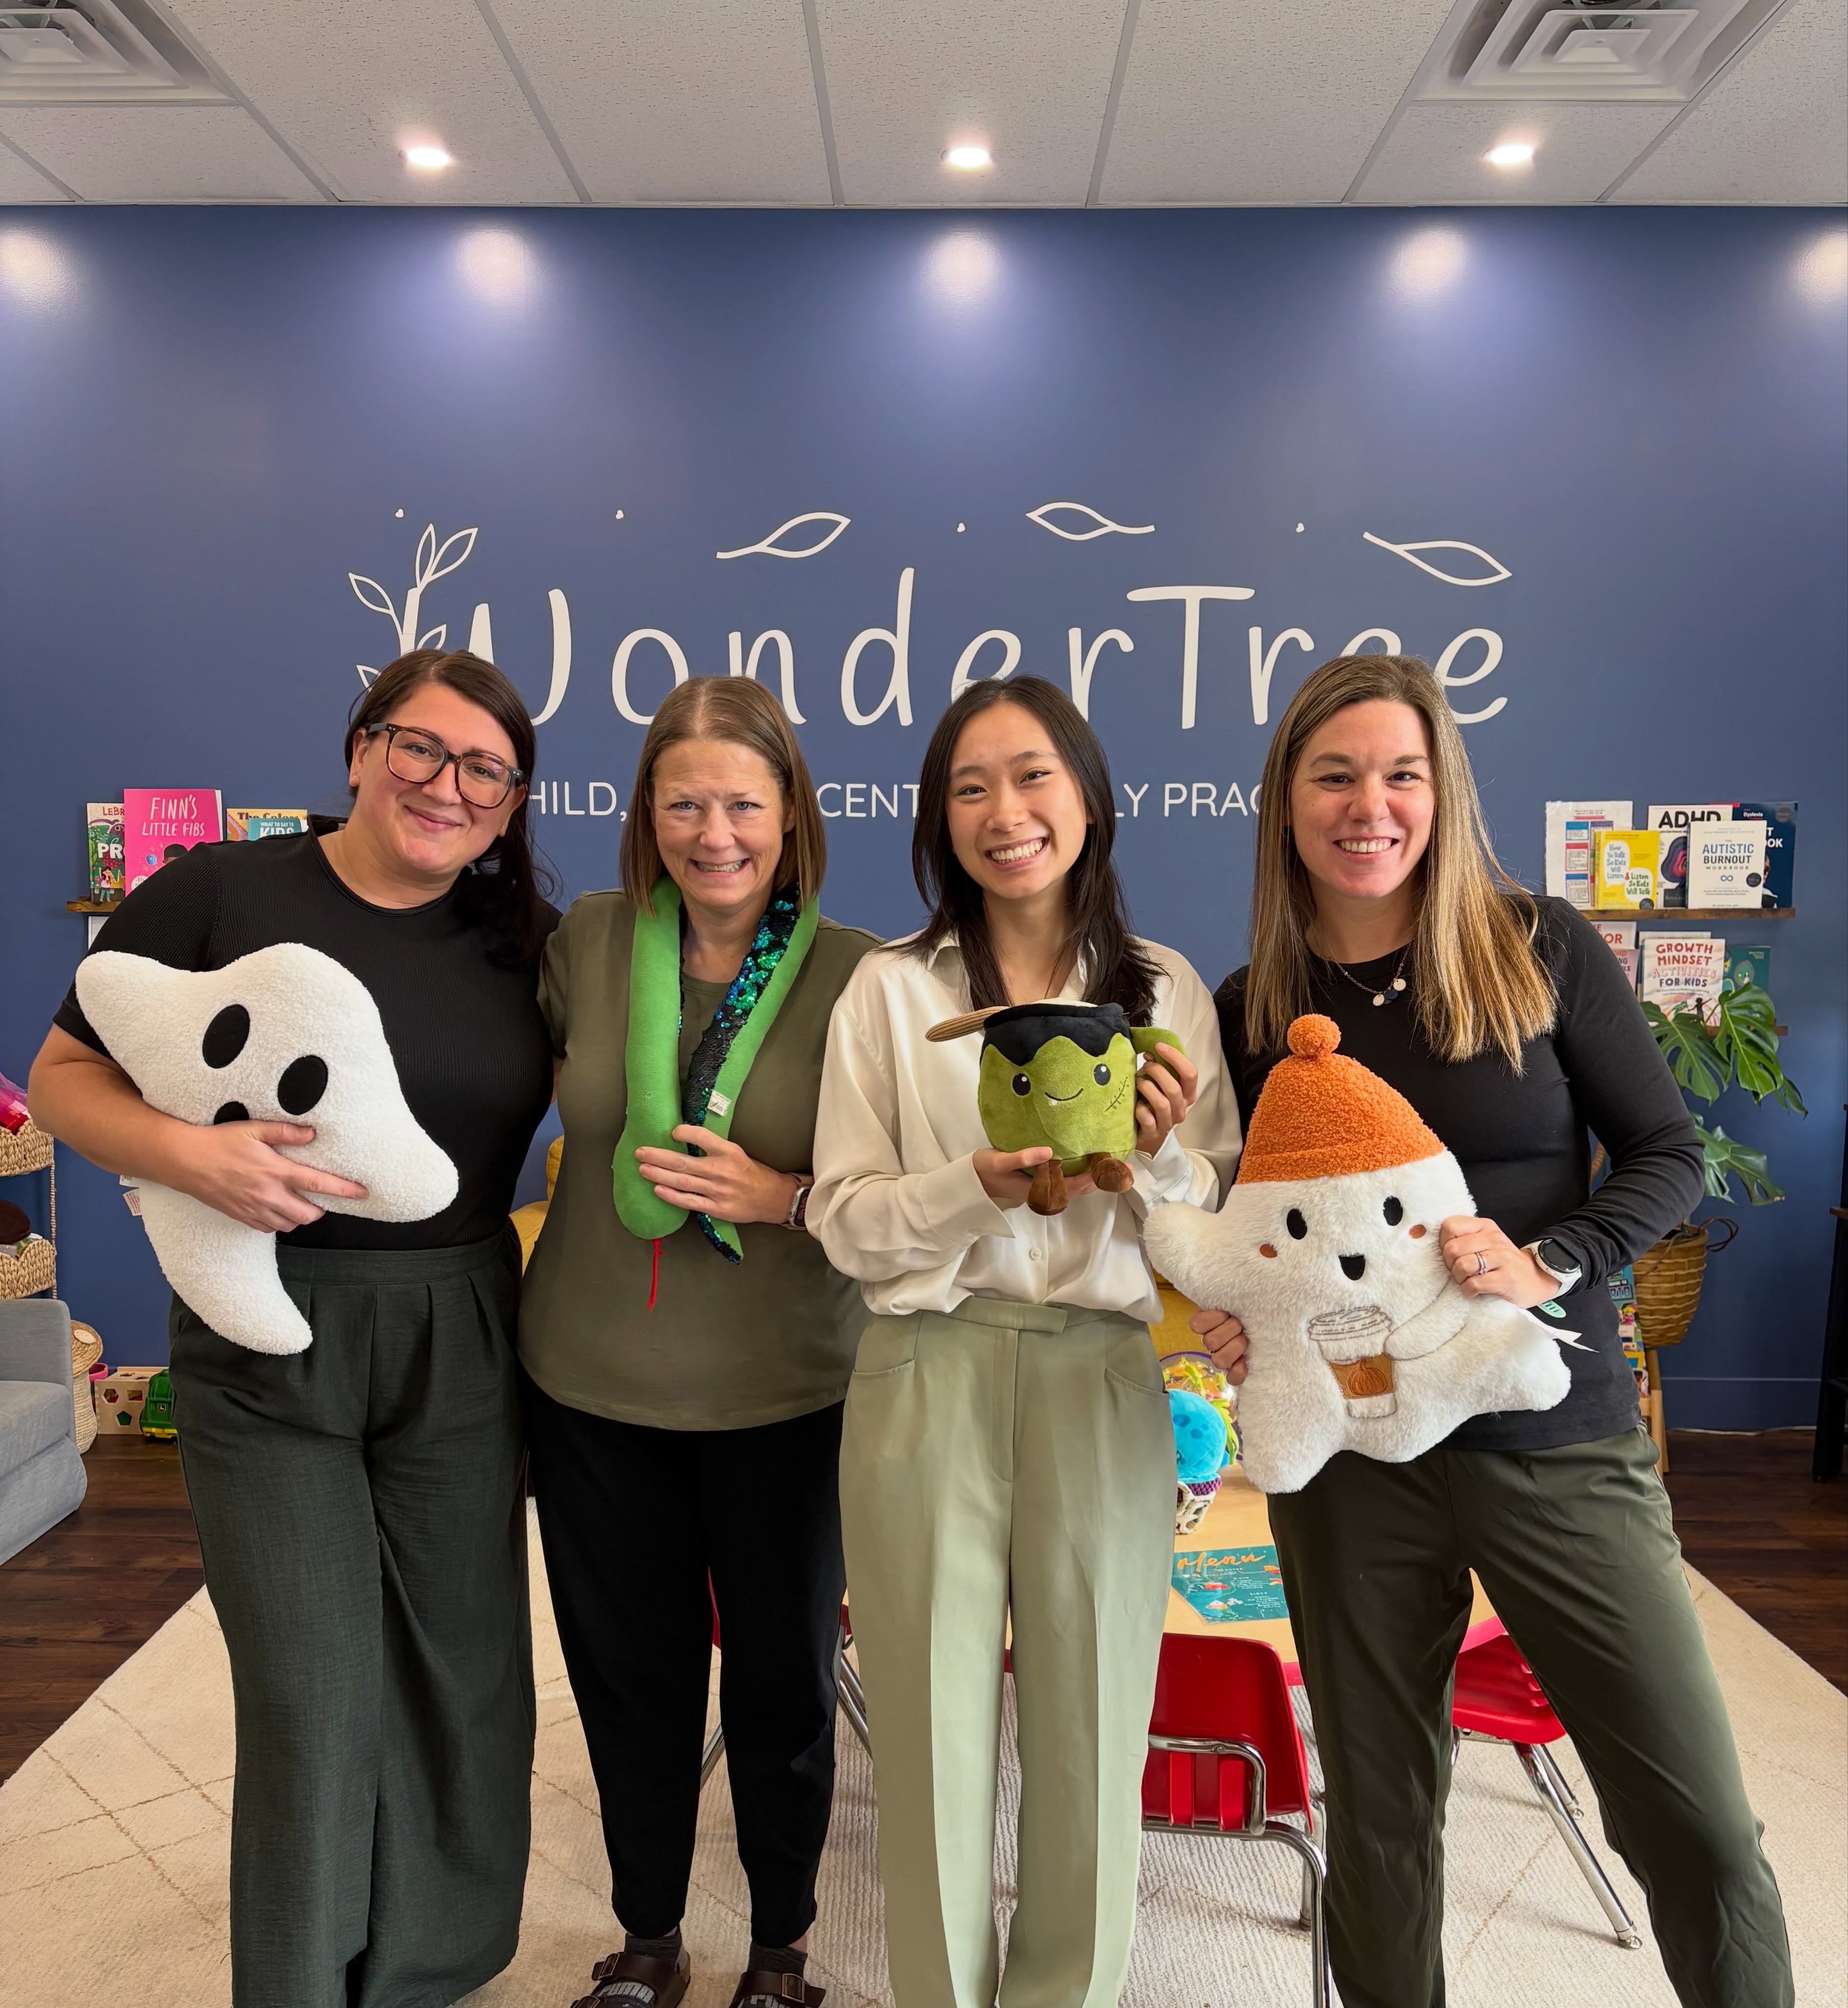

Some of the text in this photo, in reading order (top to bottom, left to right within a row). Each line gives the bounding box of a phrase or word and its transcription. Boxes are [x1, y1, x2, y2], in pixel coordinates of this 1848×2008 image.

[150, 794, 198, 820] FINN'S
[529, 781, 627, 822] HILD,
[1658, 810, 1721, 828] ADHD
[142, 822, 205, 837] LITTLE FIBS
[98, 843, 125, 859] PR
[1702, 844, 1754, 854] AUTISTIC
[1704, 855, 1751, 864] BURNOUT
[1656, 943, 1713, 954] GROWTH
[1657, 954, 1712, 966] MINDSET
[1652, 967, 1717, 979] ACTIVITIES
[1659, 978, 1707, 987] FOR KIDS
